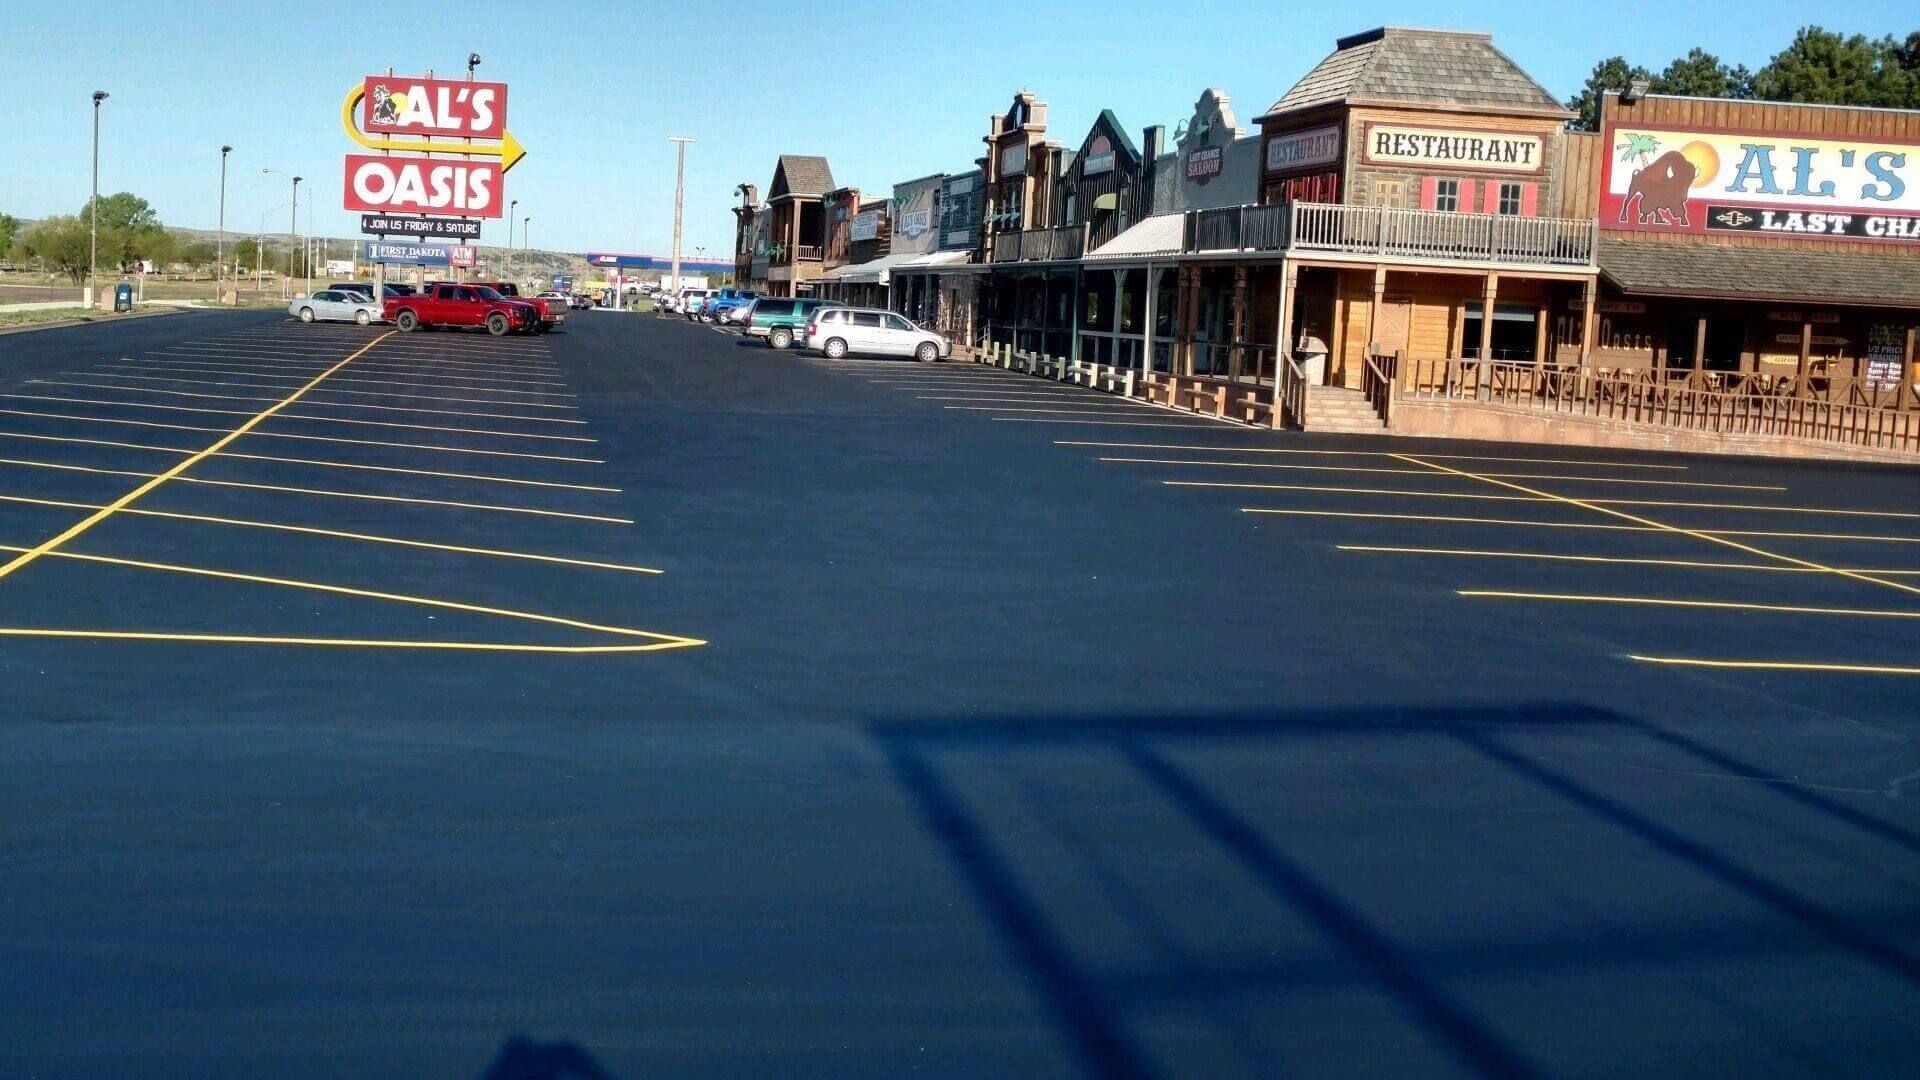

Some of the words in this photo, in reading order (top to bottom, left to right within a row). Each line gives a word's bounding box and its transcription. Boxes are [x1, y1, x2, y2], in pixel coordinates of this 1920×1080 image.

[396, 85, 494, 131] AL'S
[1190, 152, 1201, 161] LAST
[1271, 133, 1336, 164] RESTAURANT
[1375, 132, 1537, 164] RESTAURANT
[1188, 159, 1220, 176] SALOON
[1725, 143, 1906, 201] AL'S
[354, 162, 492, 210] OASIS
[369, 219, 388, 229] JOIN
[390, 220, 402, 230] US
[404, 221, 433, 232] FRIDAY
[436, 222, 443, 232] &
[1760, 211, 1851, 235] LAST
[380, 246, 407, 255] FIRST
[409, 247, 446, 257] DAKOTA
[452, 247, 472, 260] ATM
